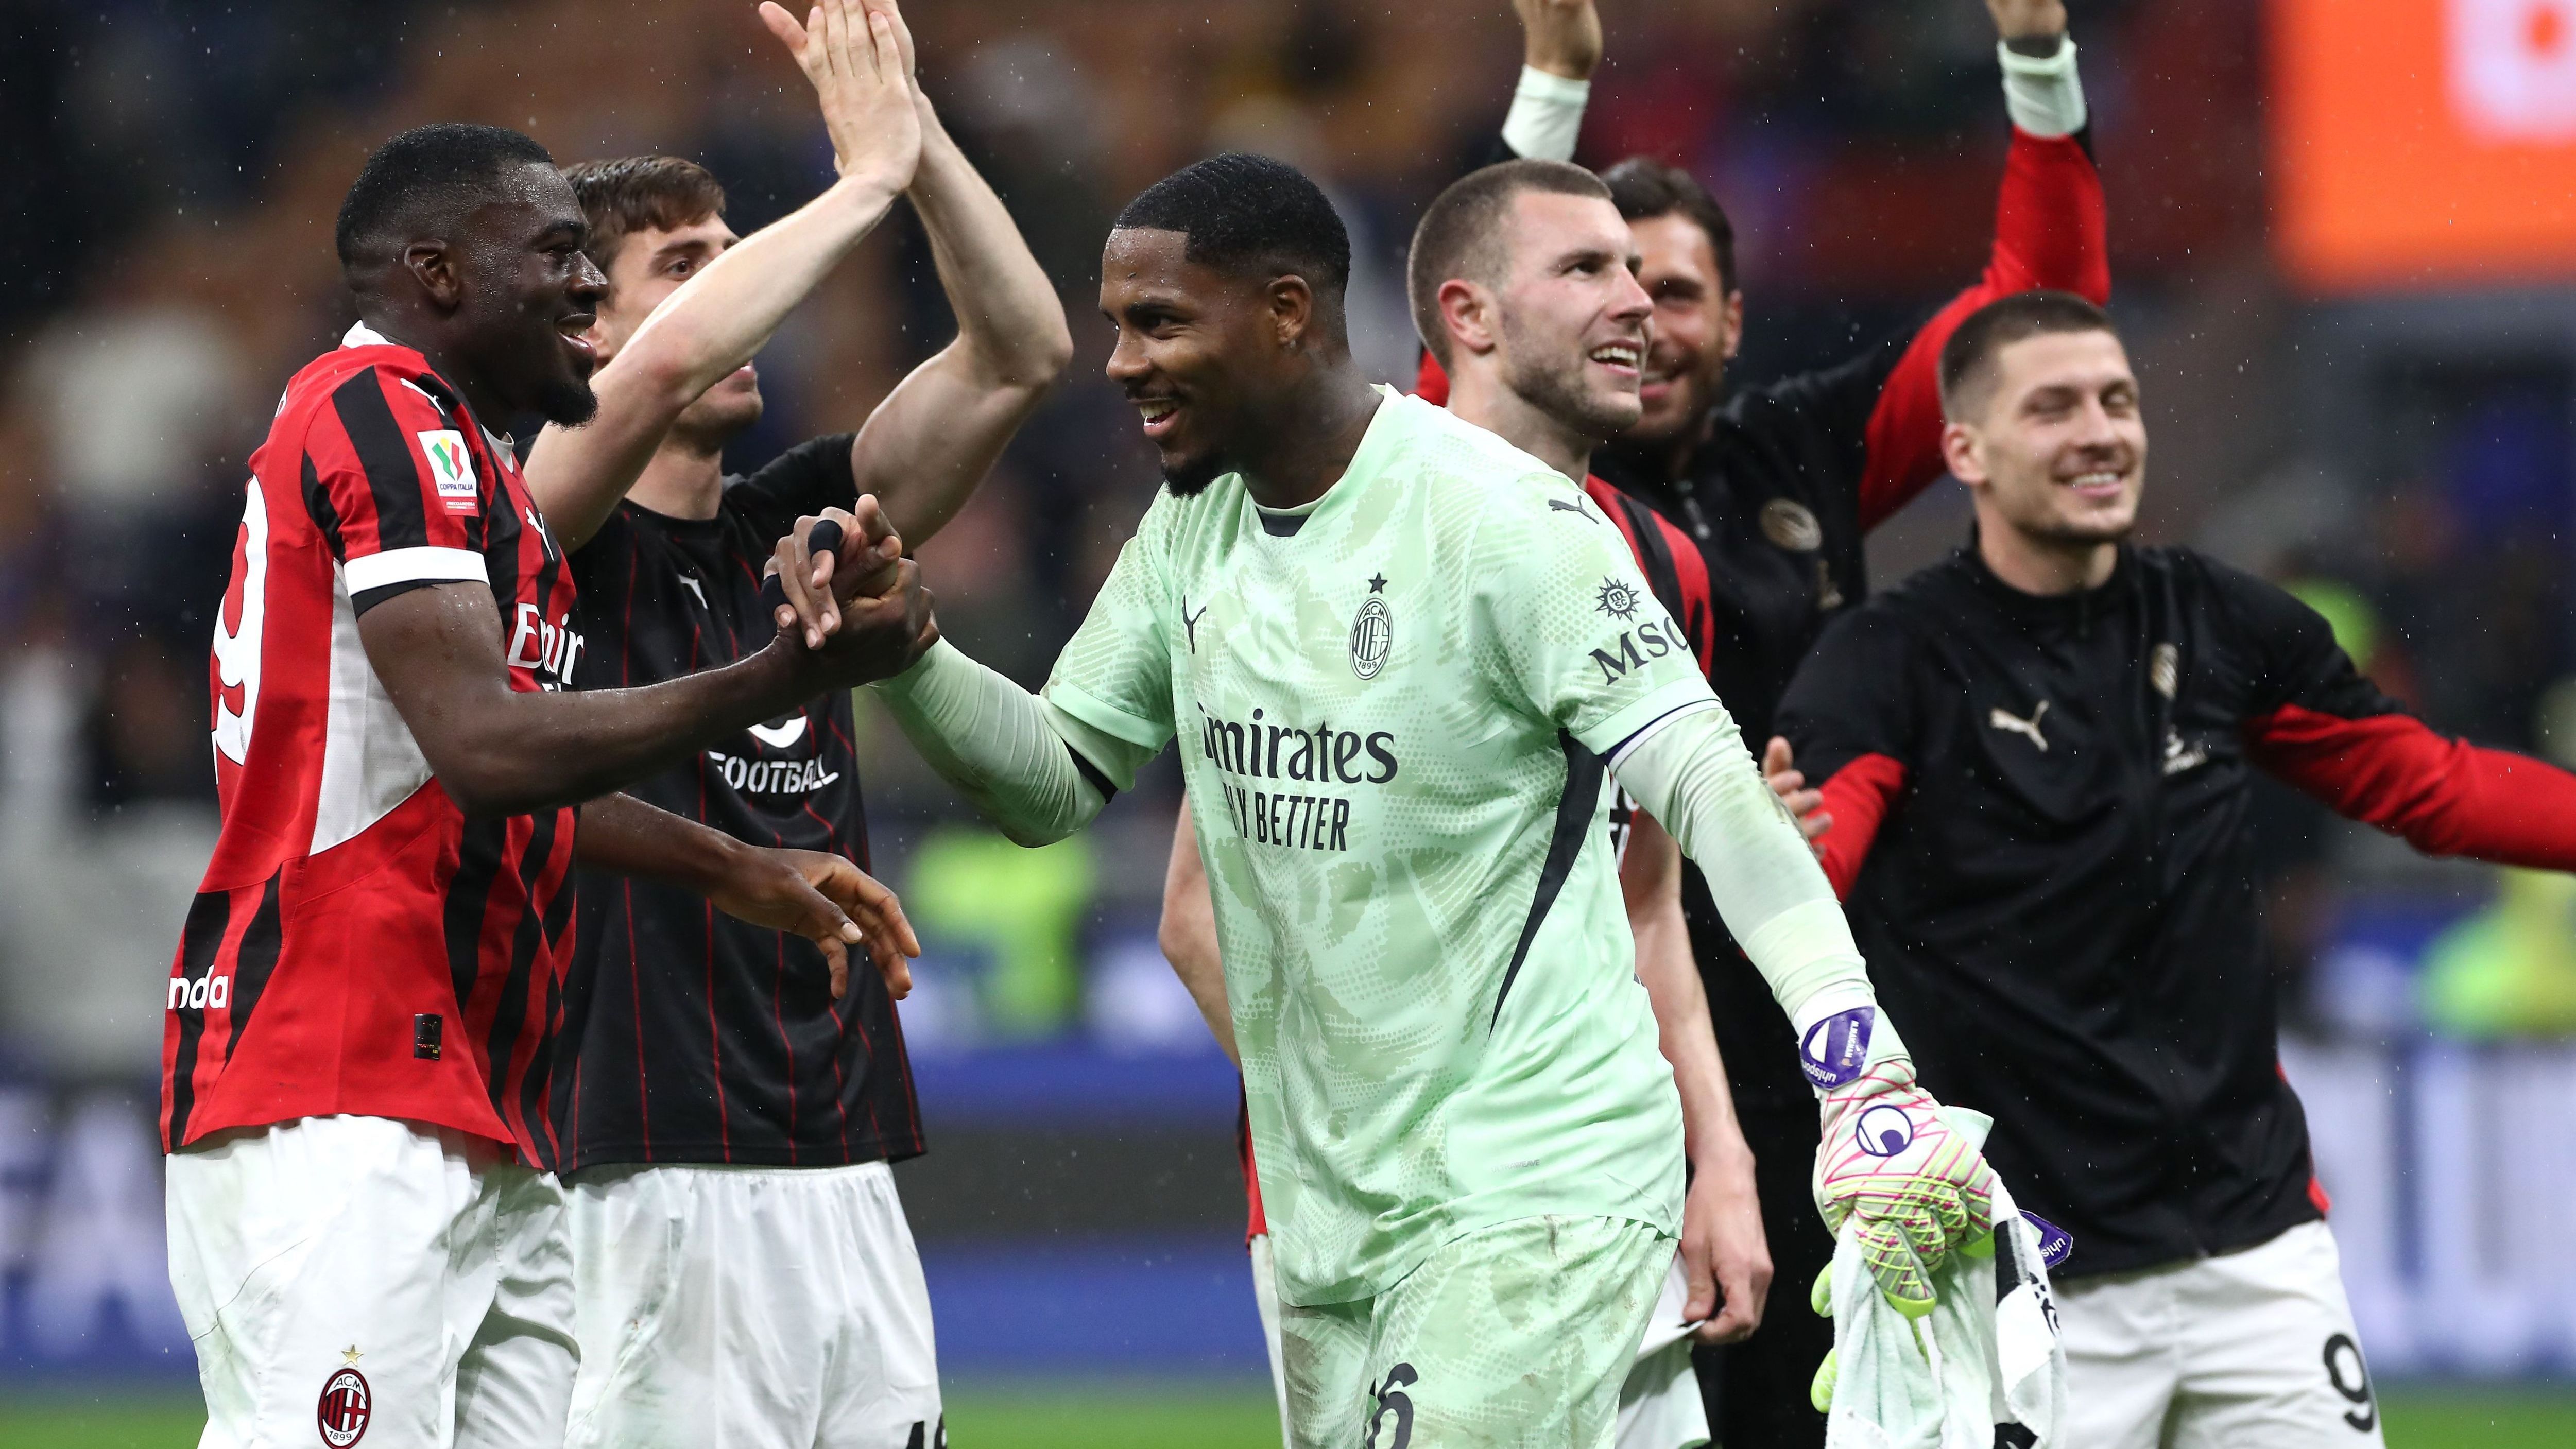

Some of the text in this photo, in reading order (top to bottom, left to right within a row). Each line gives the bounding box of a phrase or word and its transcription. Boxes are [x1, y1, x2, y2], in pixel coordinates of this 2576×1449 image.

[211, 474, 268, 786] 9
[1362, 605, 1385, 619] ACM
[1358, 661, 1377, 669] 1899
[1588, 616, 1688, 686] MSC
[1255, 791, 1350, 852] BETTER
[167, 964, 229, 1010] nda
[333, 1376, 362, 1392] ACM
[1365, 1362, 1419, 1449] 6
[2323, 1333, 2374, 1432] 9
[329, 1430, 352, 1441] 1899
